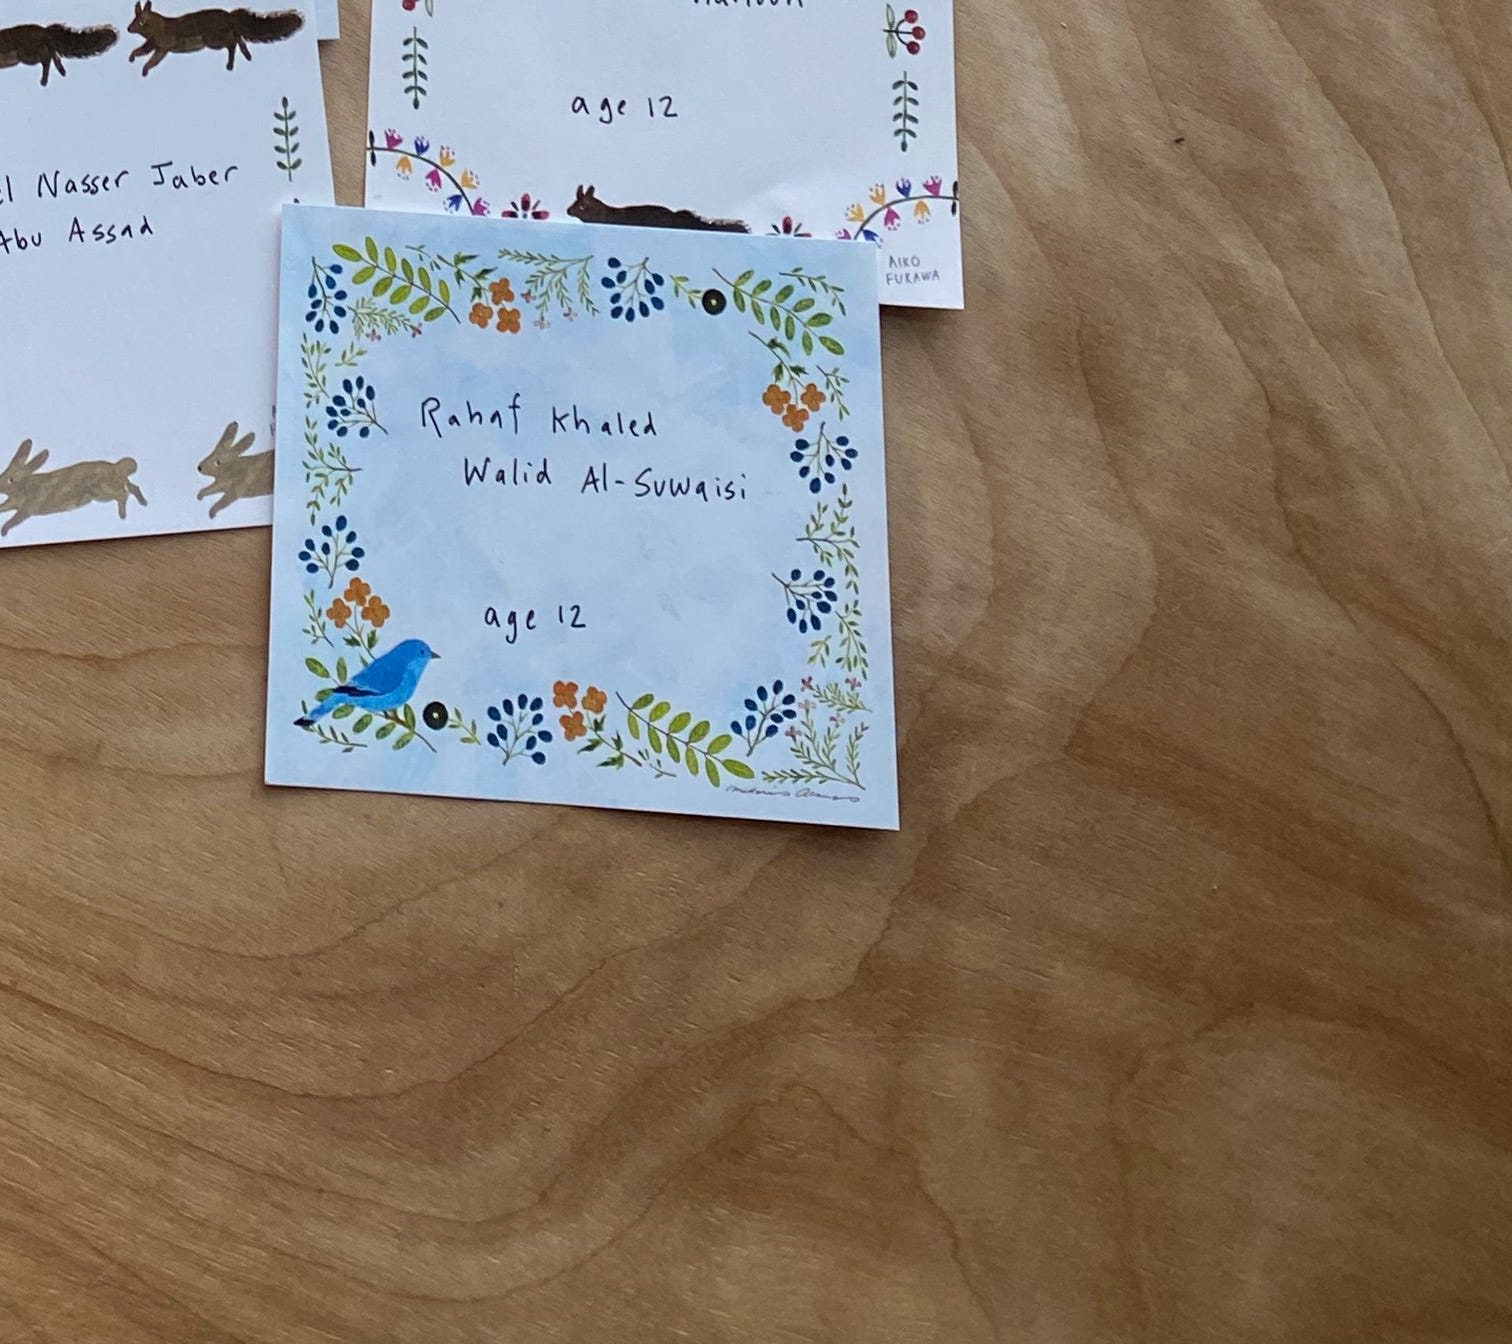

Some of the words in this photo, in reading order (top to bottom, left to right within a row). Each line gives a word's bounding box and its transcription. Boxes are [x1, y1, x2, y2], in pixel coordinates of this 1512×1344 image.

[571, 95, 627, 125] age
[647, 95, 679, 118] 12
[37, 169, 130, 199] Nasser
[150, 160, 239, 190] Jaber
[68, 215, 154, 245] Assad
[886, 270, 940, 285] FUKAWA
[889, 255, 920, 268] AIKO
[420, 392, 521, 439] Rahaf
[551, 403, 657, 438] Khaled
[463, 456, 552, 487] Walid
[580, 462, 747, 503] Al-Suwaisi
[484, 606, 537, 645] age
[558, 604, 587, 629] 12
